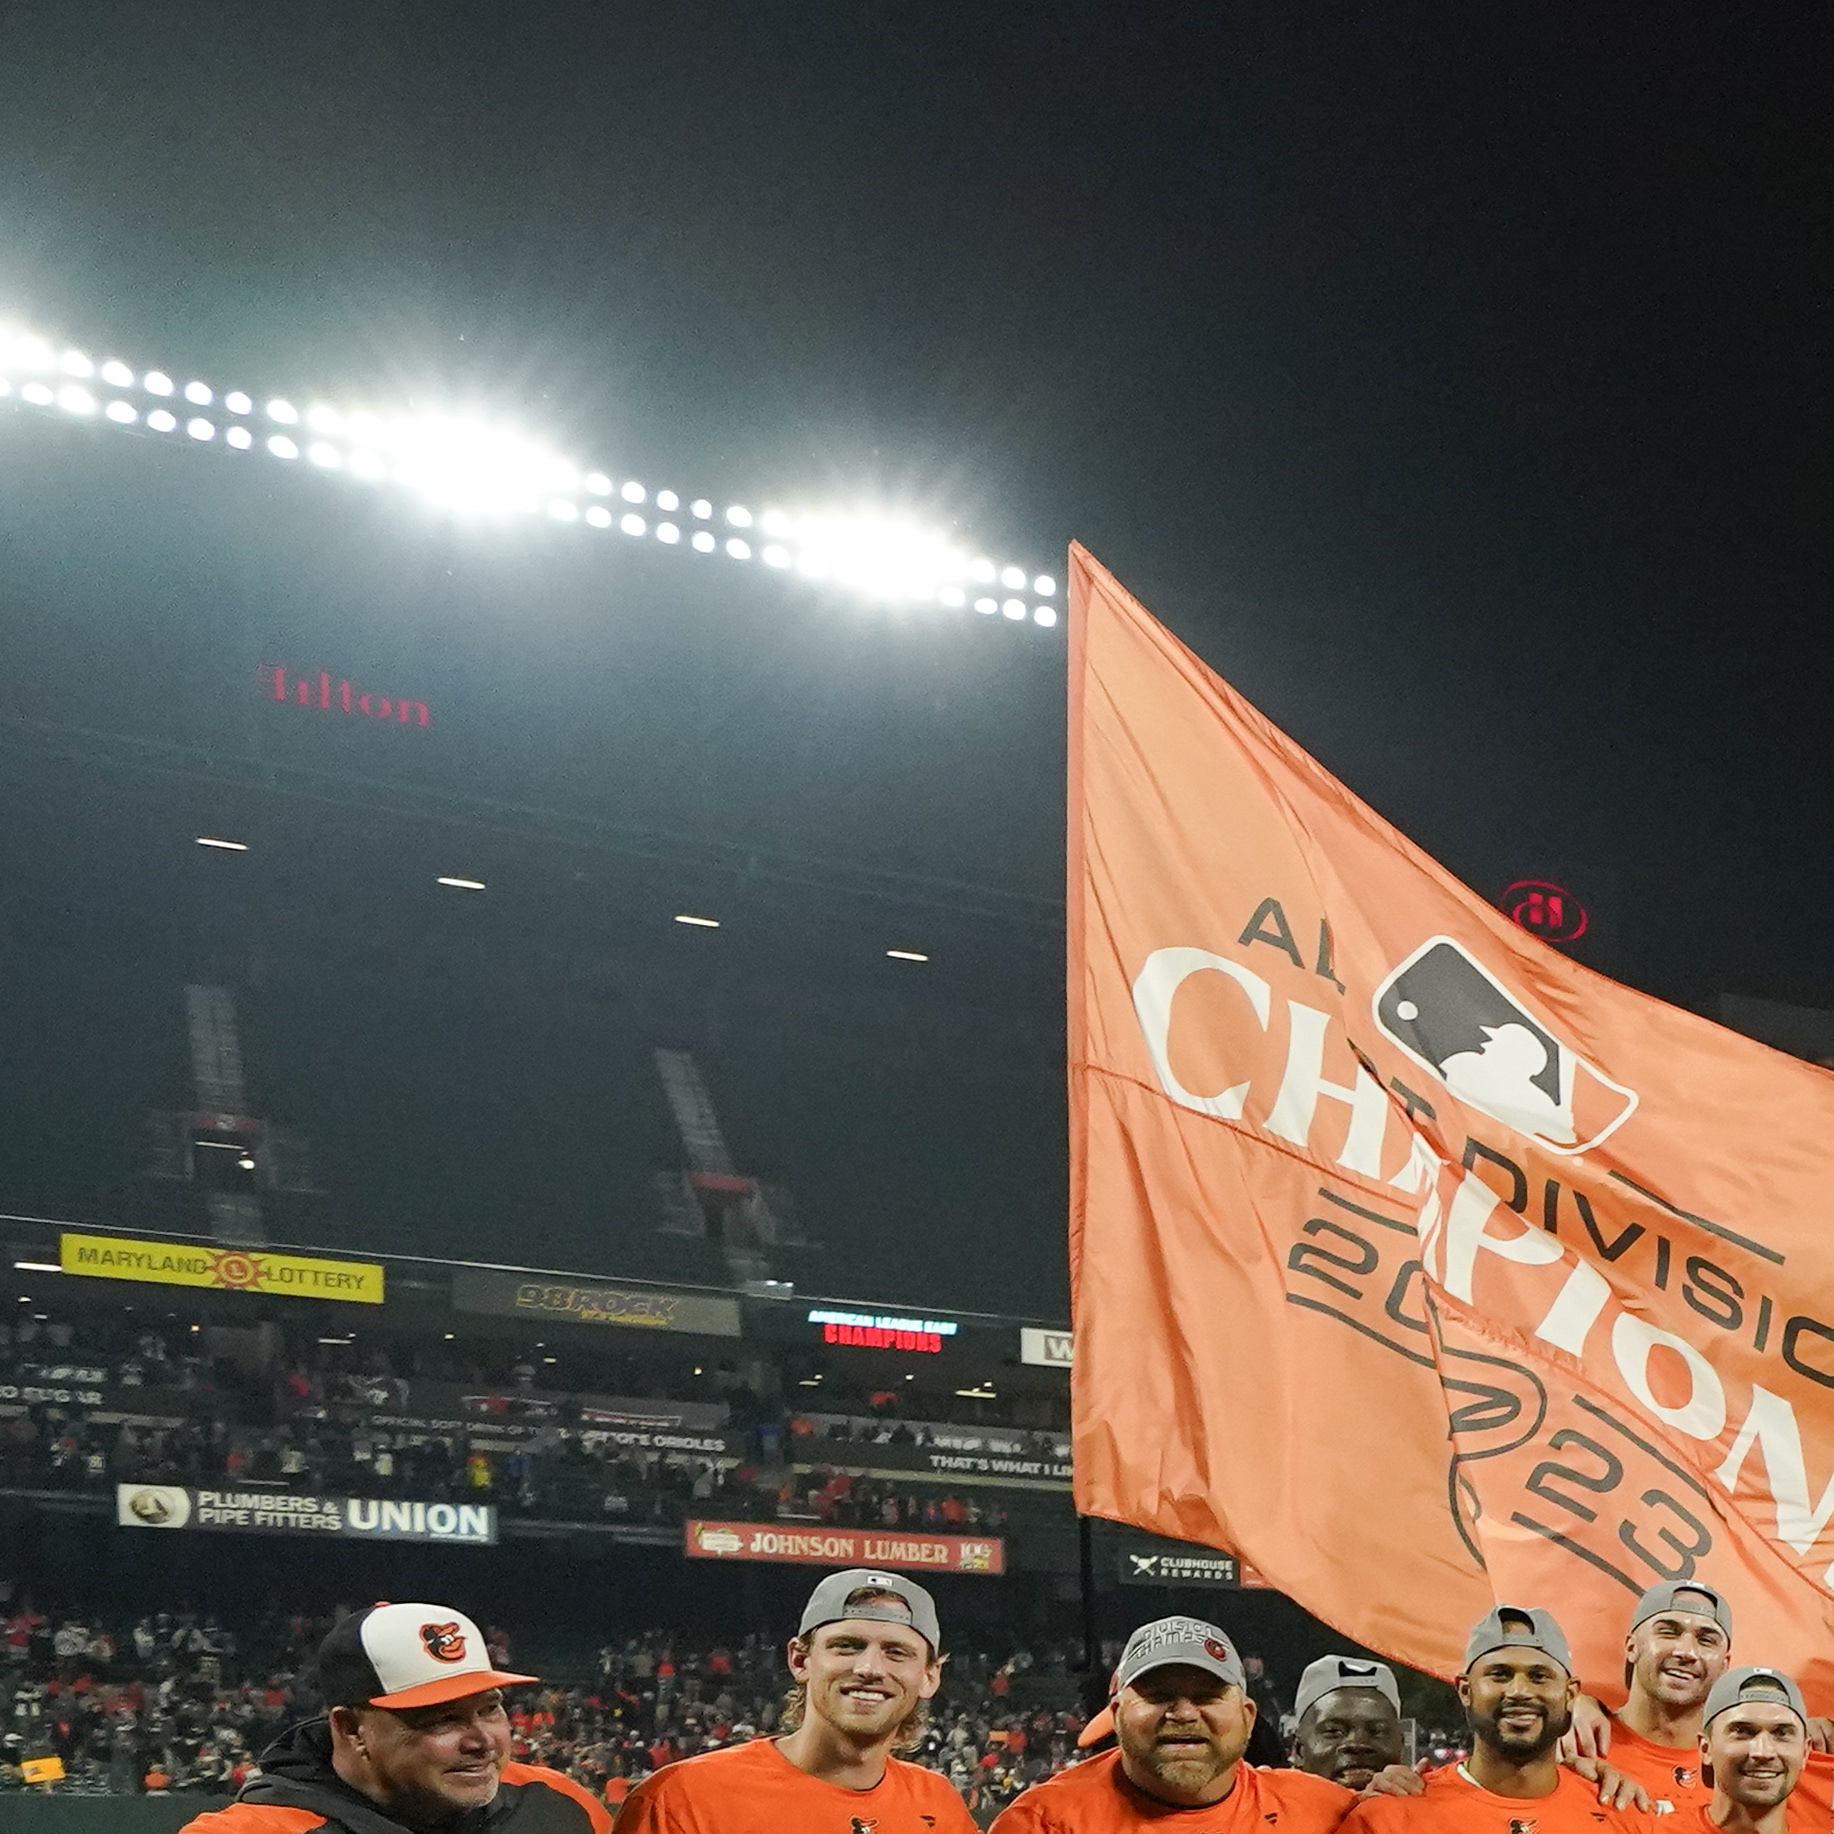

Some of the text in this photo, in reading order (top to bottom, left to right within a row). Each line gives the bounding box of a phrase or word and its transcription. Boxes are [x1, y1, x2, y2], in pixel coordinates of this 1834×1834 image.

[77, 1246, 367, 1291] MARYLAND LOTTERY
[808, 1309, 959, 1337] AMERICAN LEAGUE EAST
[823, 1323, 943, 1354] CHAMPIONS
[929, 1454, 989, 1472] THAT'S
[990, 1458, 1040, 1475] WHAT
[199, 1489, 340, 1515] PLUMBERS &
[1526, 1422, 1712, 1584] 23
[199, 1508, 343, 1531] PIPE FITTERS
[350, 1499, 489, 1535] UNION
[750, 1531, 855, 1558] JOHNSON
[864, 1538, 950, 1564] LUMBER
[1159, 1555, 1234, 1571] CLUBHOUSE
[1160, 1568, 1234, 1581] REWARDS
